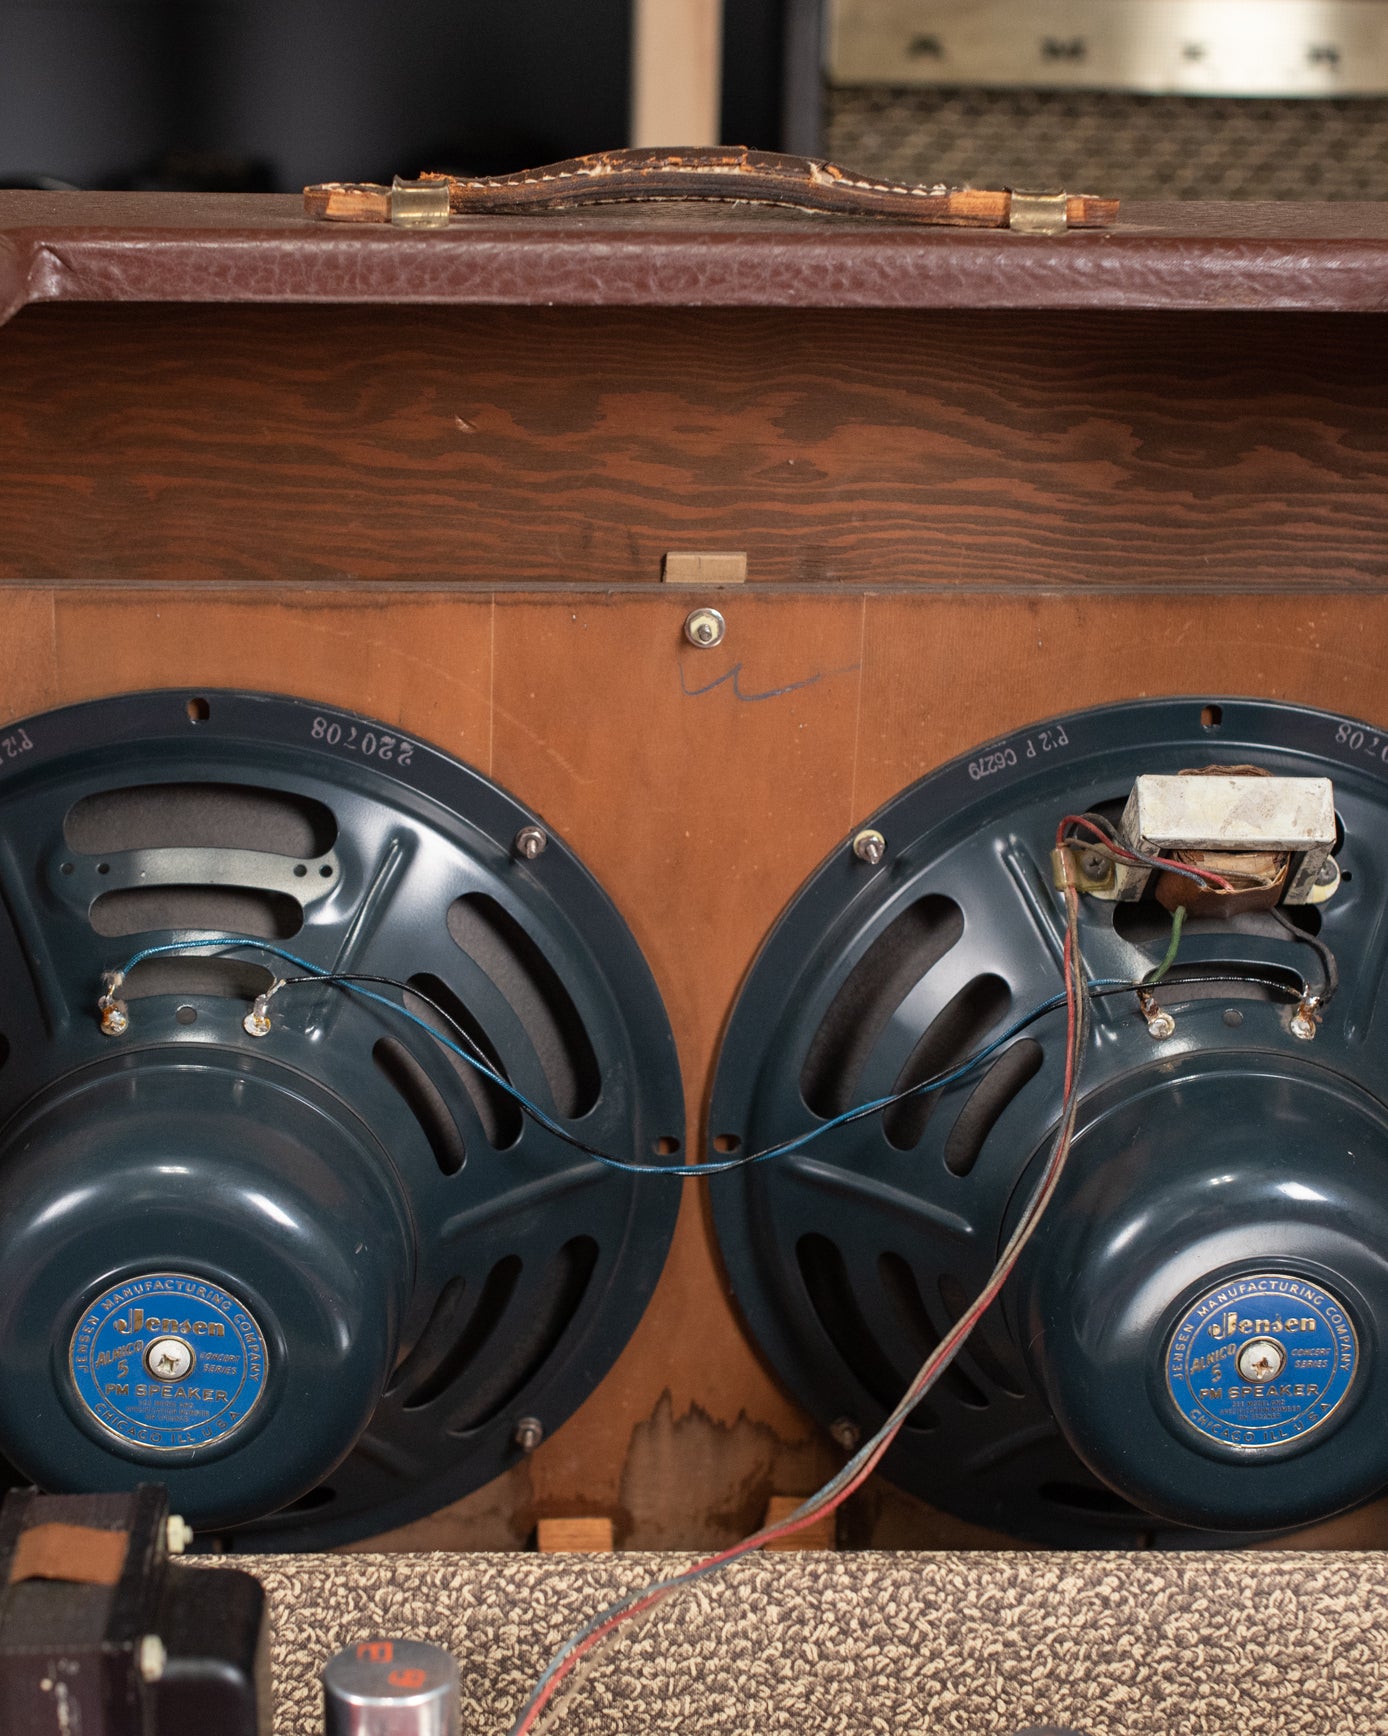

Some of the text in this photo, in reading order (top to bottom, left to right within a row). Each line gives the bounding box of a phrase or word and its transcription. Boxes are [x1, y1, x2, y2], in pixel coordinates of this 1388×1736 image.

[311, 717, 414, 767] 220708
[1026, 739, 1037, 758] P
[968, 748, 1018, 781] C6279
[76, 1279, 260, 1383] JENSEN MANUFACTURING COMPANY
[113, 1308, 225, 1337] Jensen
[1173, 1280, 1351, 1380] JENSEN MANUFACTURING COMPANY
[1207, 1312, 1317, 1341] Jensen
[95, 1340, 144, 1369] ALNICO
[1190, 1343, 1237, 1375] ALNICO
[1295, 1359, 1329, 1369] SERIES
[117, 1360, 129, 1379] 5
[1211, 1364, 1222, 1383] 5
[105, 1384, 229, 1403] PM SPEAKER
[1199, 1383, 1320, 1401] PM SPEAKER
